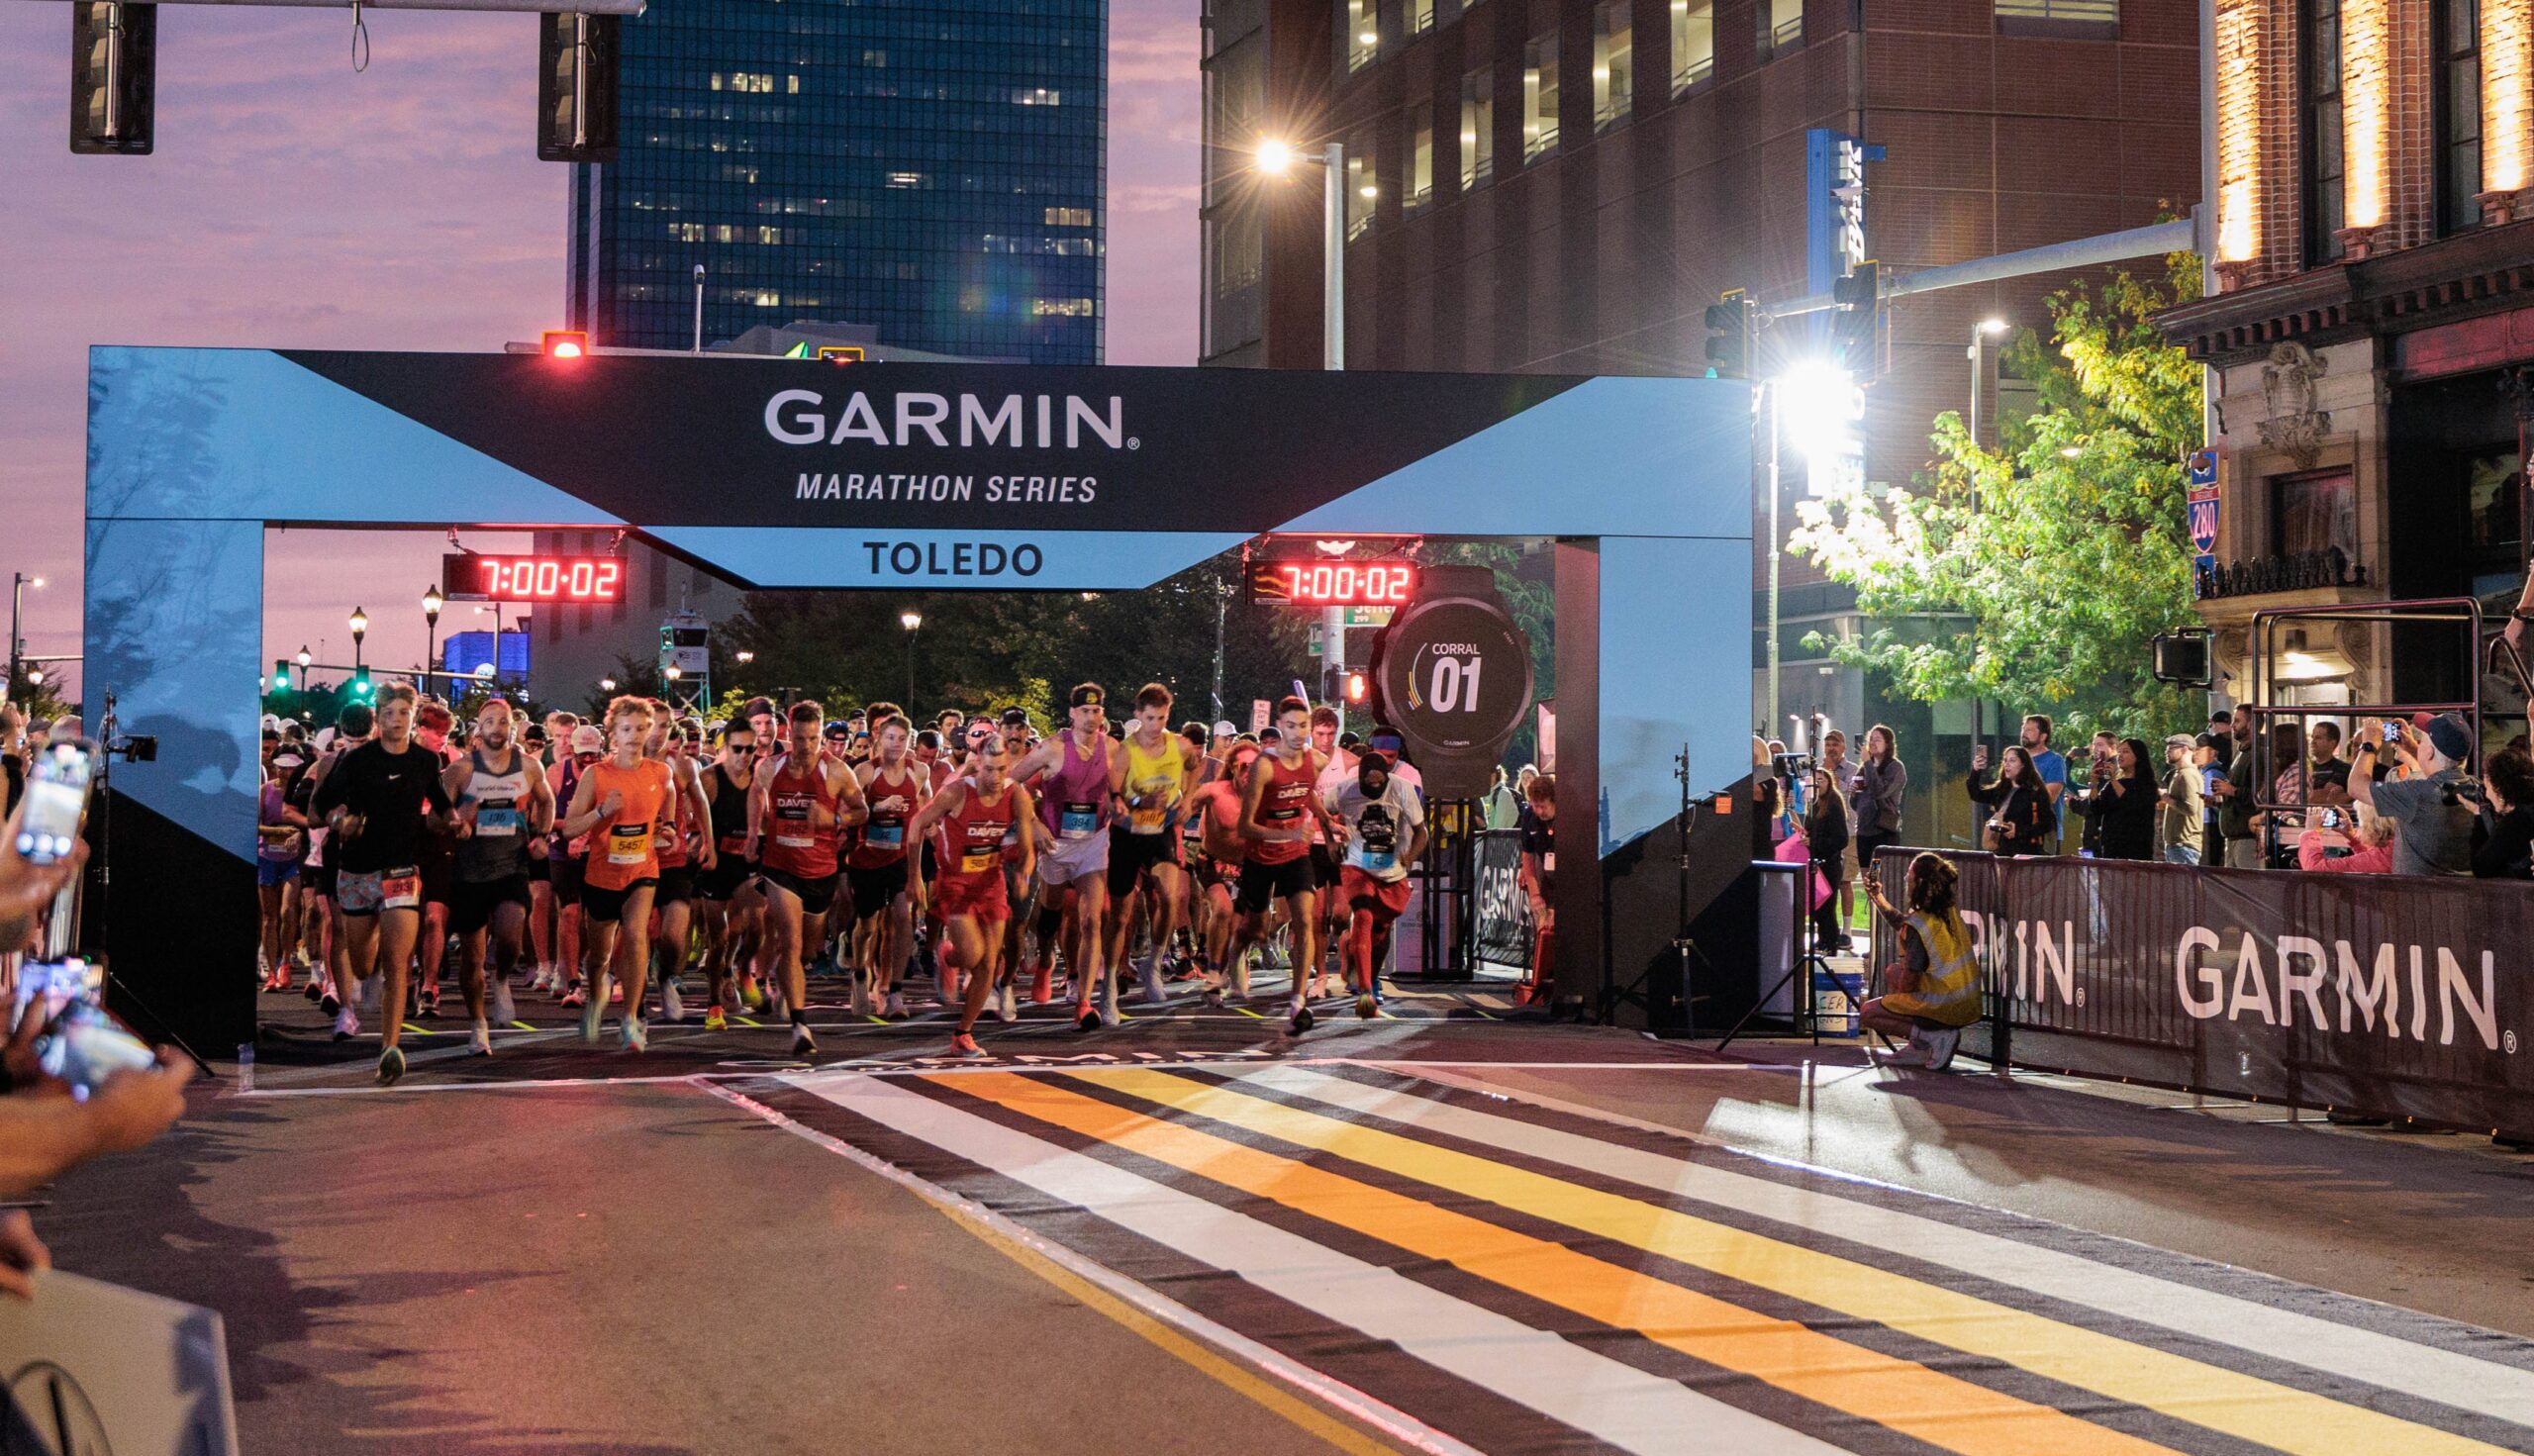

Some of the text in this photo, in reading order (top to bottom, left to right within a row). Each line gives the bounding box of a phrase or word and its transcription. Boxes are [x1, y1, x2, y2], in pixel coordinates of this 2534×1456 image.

[795, 472, 1098, 503] MARATHON SERIES
[2193, 502, 2216, 539] 280
[863, 540, 1043, 577] TOLEDO
[1431, 643, 1481, 655] CORRAL
[1429, 656, 1482, 714] 01
[1070, 817, 1091, 827] 394
[618, 838, 643, 850] 5457
